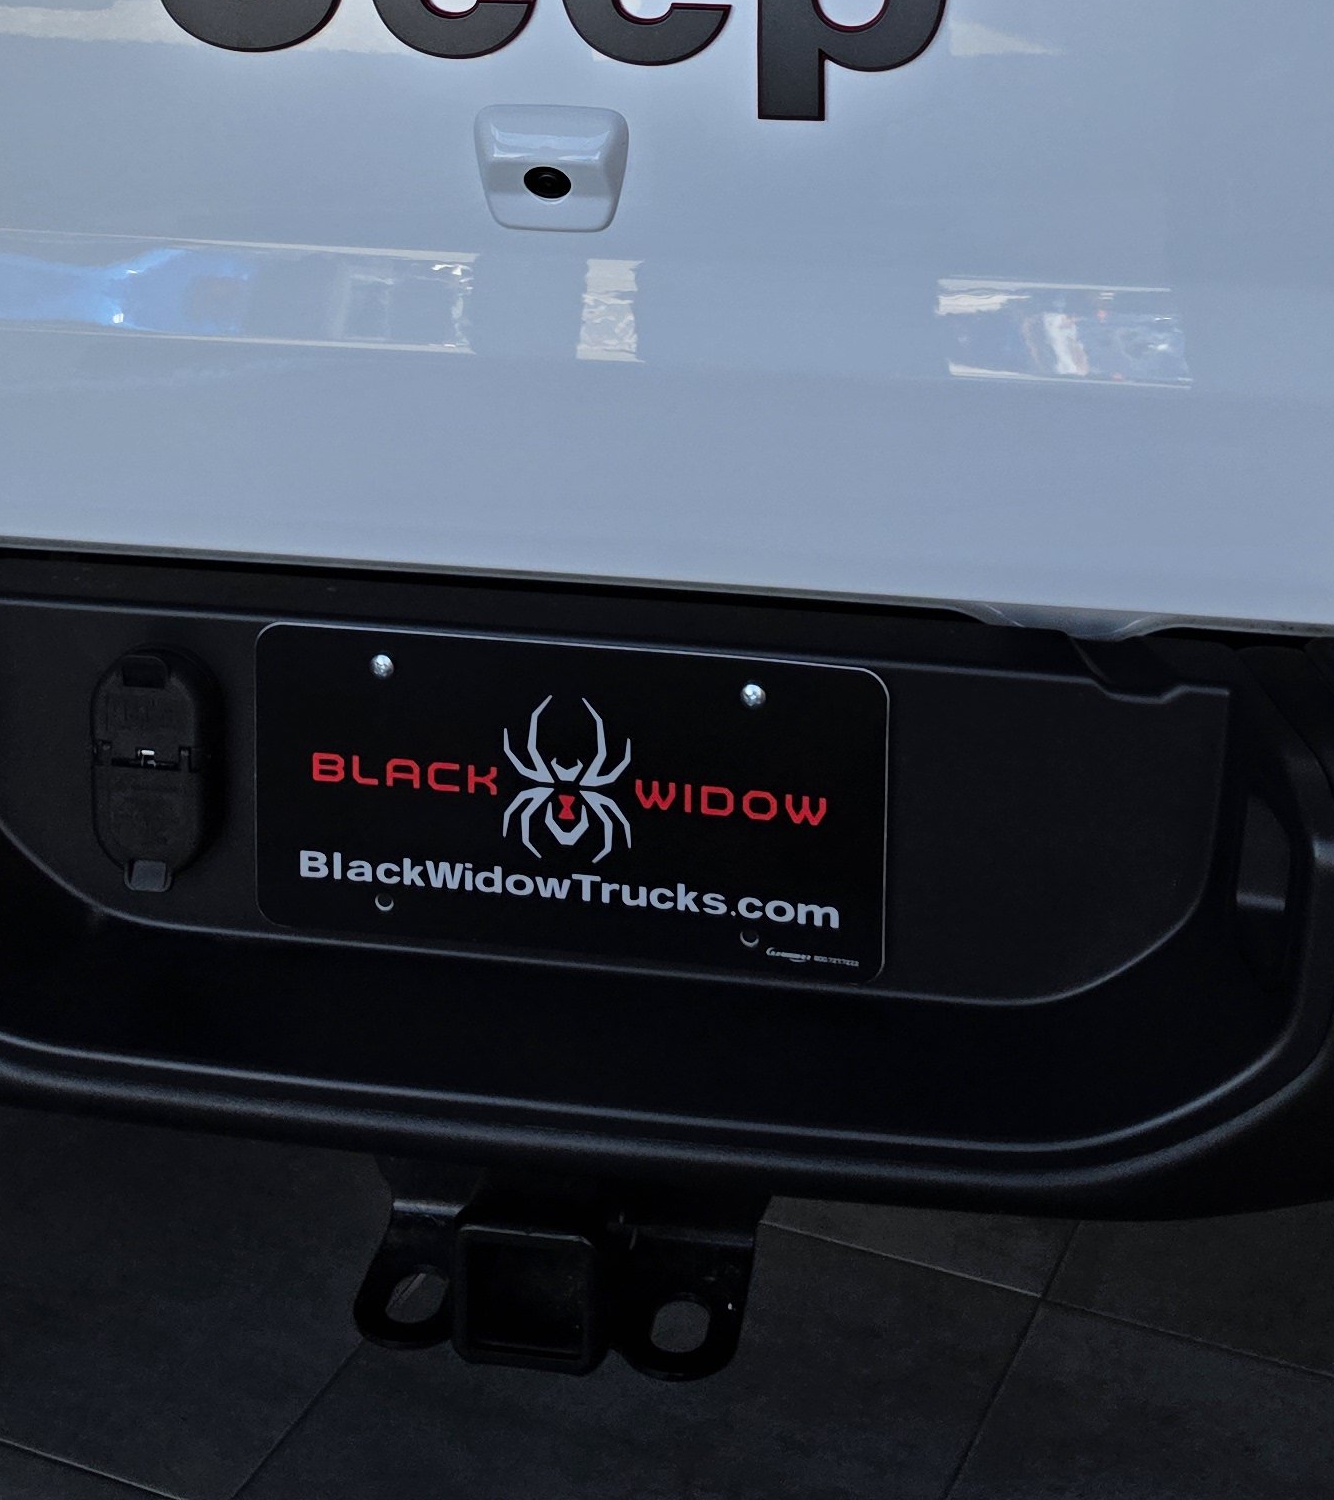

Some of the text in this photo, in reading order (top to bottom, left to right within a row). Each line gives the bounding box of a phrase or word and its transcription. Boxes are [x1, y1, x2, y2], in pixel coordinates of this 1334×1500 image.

[311, 751, 828, 827] BLACK WIDOW
[299, 850, 840, 929] BlackWidowTrucks.com
